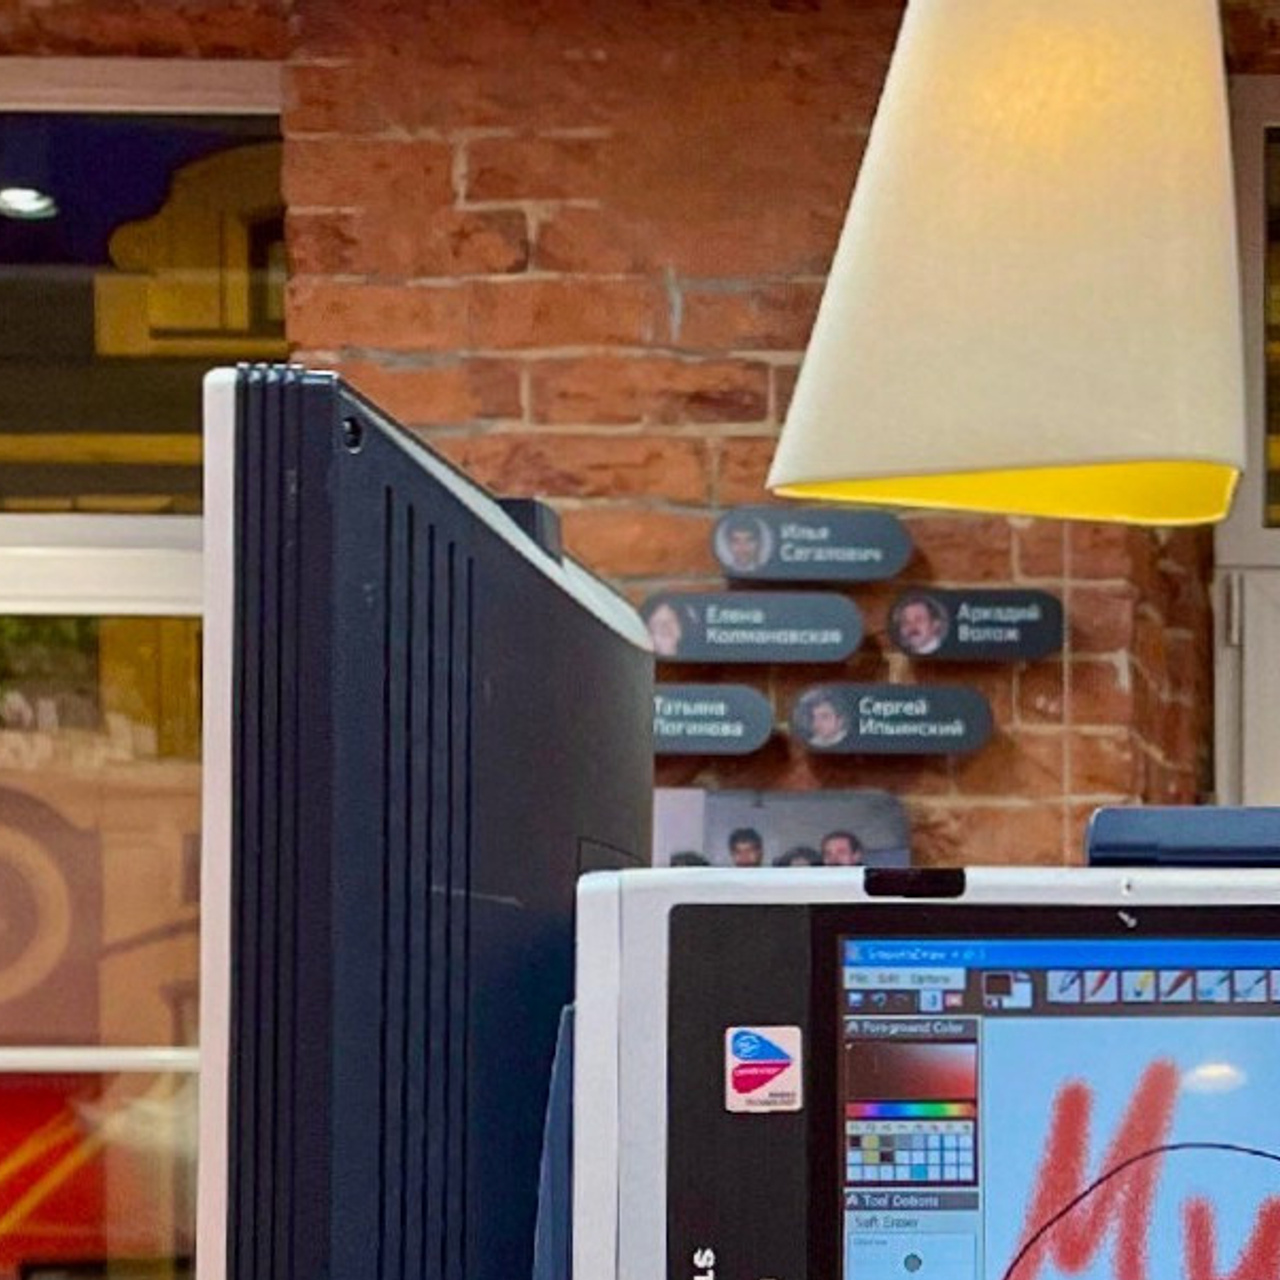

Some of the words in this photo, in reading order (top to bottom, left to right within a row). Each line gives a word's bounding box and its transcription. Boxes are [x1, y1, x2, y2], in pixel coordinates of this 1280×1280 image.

[781, 523, 829, 540] Илья
[706, 605, 764, 624] Елена
[957, 602, 1041, 623] Аркадий
[957, 624, 1020, 643] Волож
[653, 696, 726, 716] Татьяна
[859, 696, 927, 718] Сергей
[859, 718, 964, 737] Ильинский
[863, 1194, 889, 1208] Tool
[892, 1194, 940, 1209] Options
